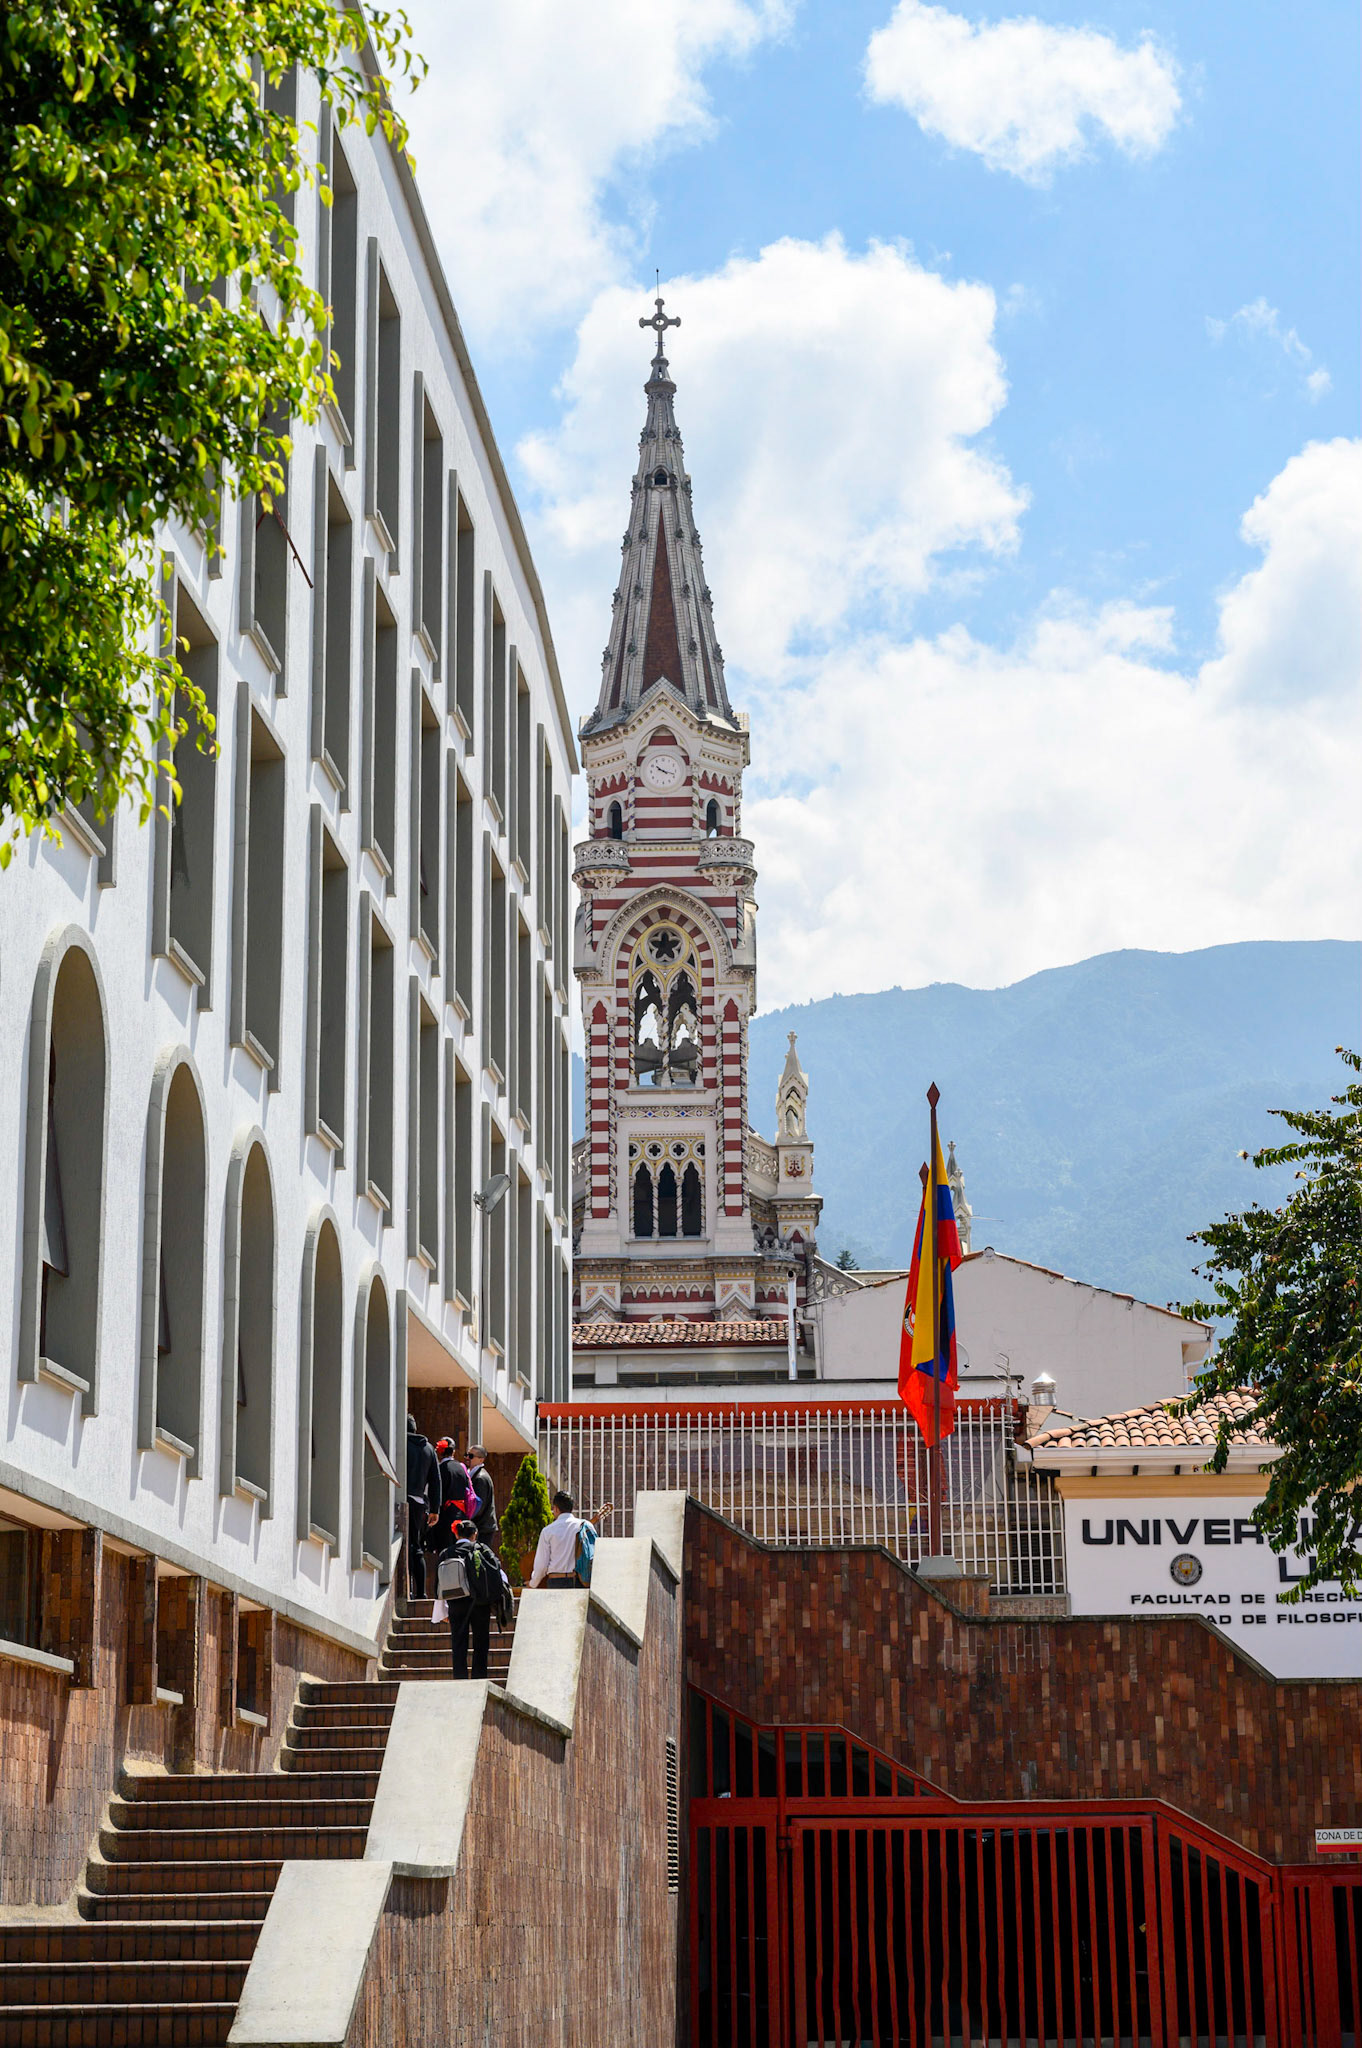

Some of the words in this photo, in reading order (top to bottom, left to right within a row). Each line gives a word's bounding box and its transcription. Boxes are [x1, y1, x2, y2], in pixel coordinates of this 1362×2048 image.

[1131, 1594, 1231, 1604] FACULTAD
[1241, 1594, 1265, 1604] DE
[1242, 1614, 1267, 1624] DE
[1316, 1831, 1341, 1841] ZONA
[1343, 1831, 1355, 1840] DE
